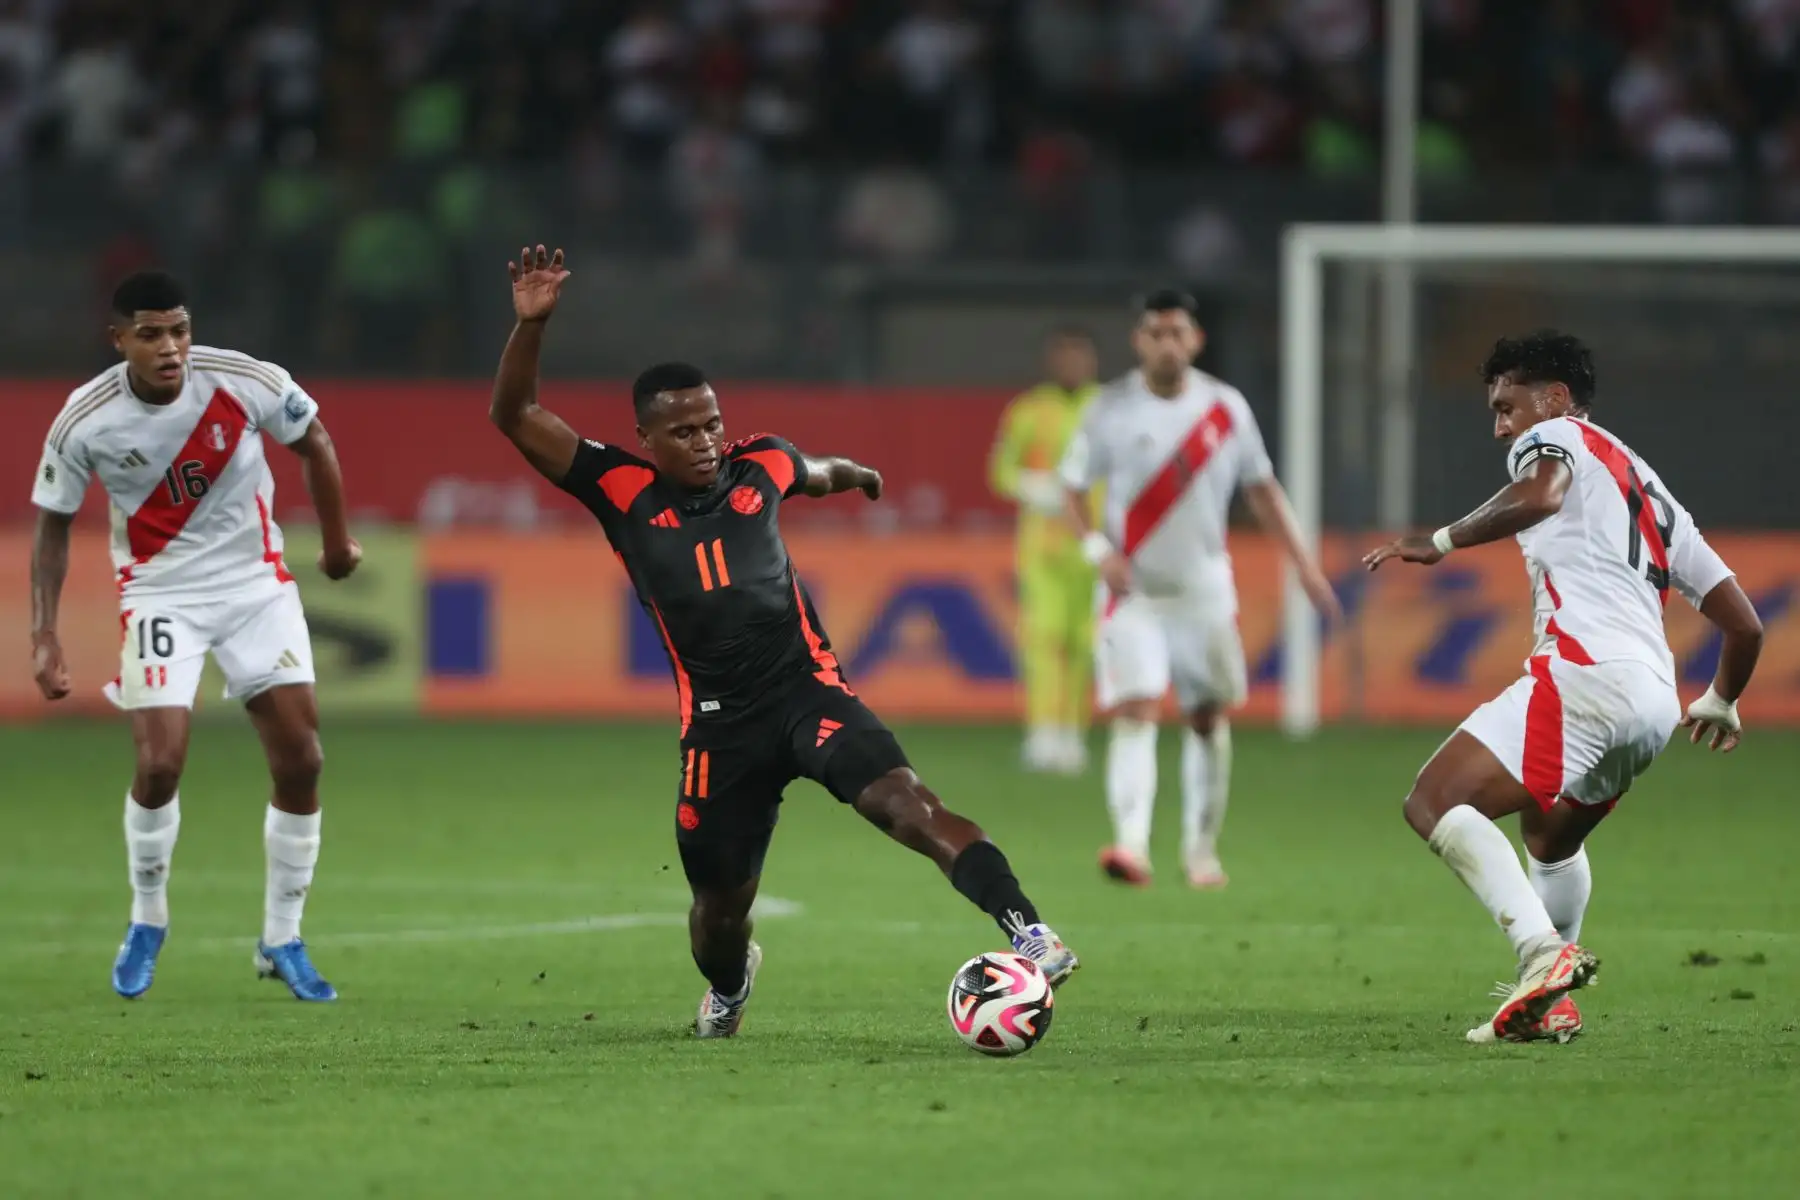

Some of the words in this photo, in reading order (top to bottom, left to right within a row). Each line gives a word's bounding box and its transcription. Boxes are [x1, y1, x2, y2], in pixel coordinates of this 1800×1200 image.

[165, 460, 211, 505] 16
[695, 538, 731, 592] 11
[138, 616, 175, 659] 16
[684, 747, 709, 799] 11
